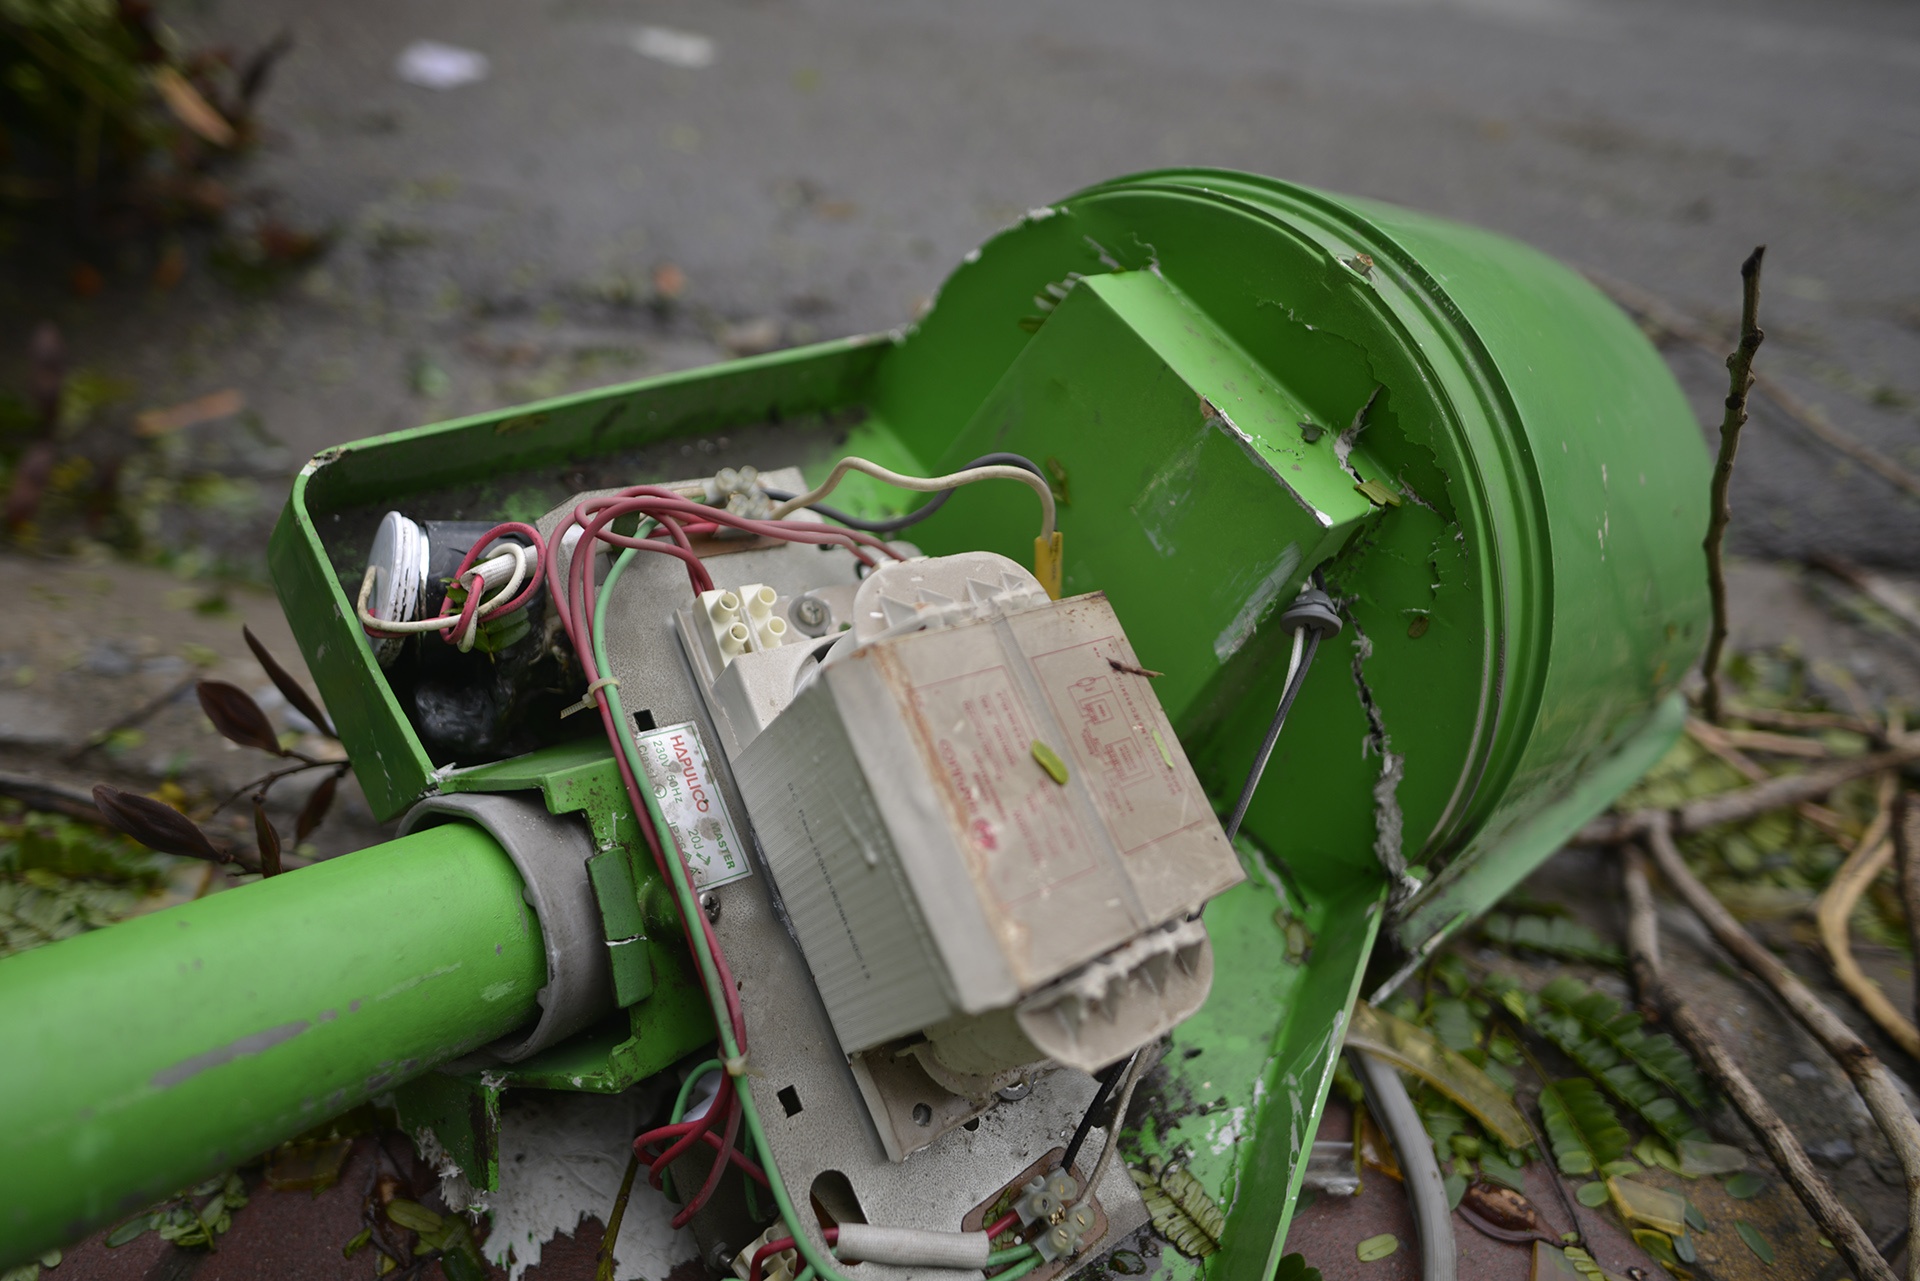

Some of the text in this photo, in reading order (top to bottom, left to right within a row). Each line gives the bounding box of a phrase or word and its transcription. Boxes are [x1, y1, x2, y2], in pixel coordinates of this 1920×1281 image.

[653, 740, 670, 767] 230V
[666, 774, 683, 804] 50Hz
[670, 735, 735, 870] HAPULICO MASTER
